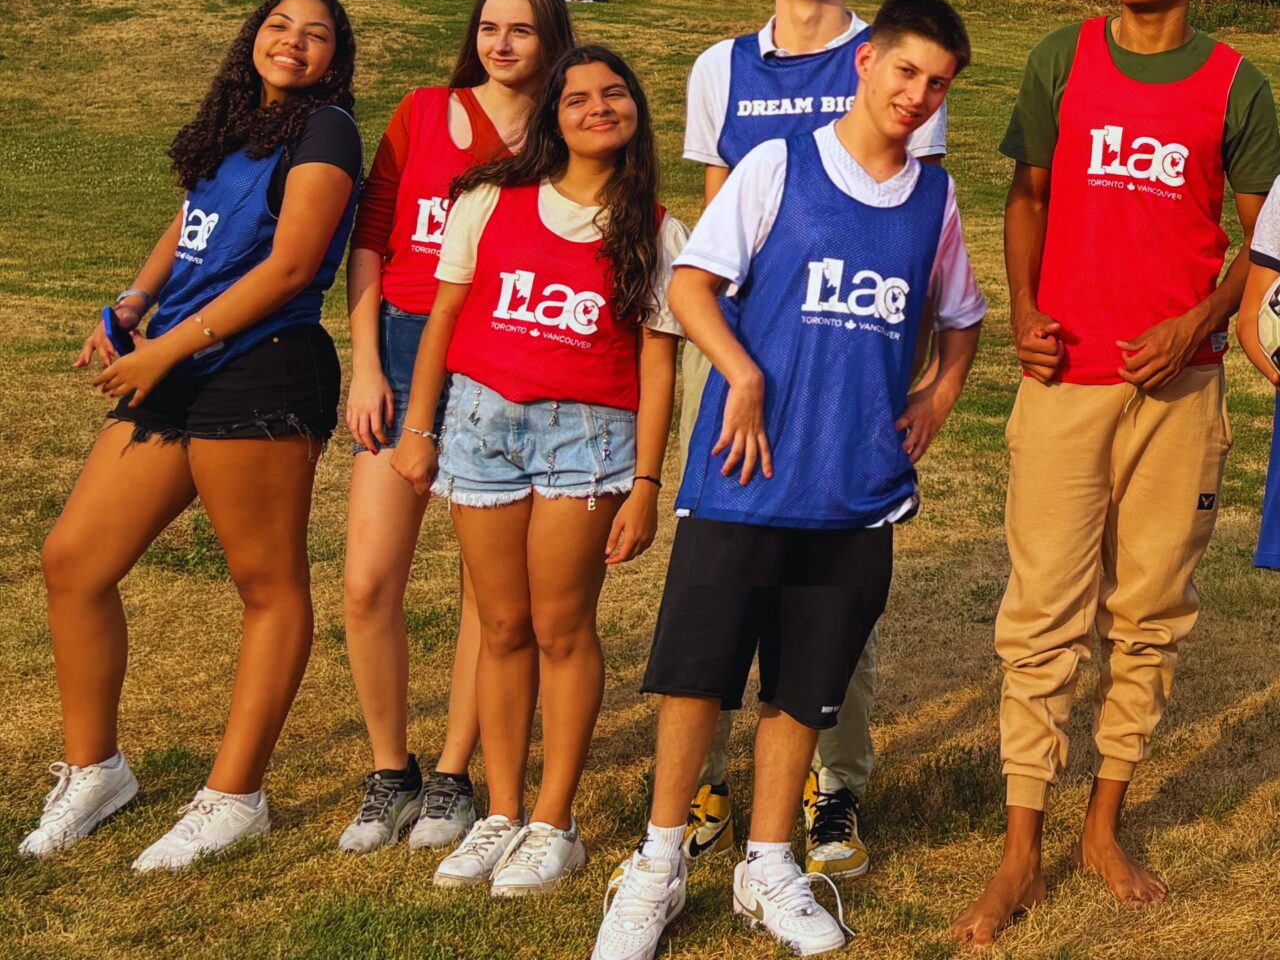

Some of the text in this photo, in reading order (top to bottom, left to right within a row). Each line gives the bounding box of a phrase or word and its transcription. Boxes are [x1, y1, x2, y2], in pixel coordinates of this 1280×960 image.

[737, 97, 814, 116] DREAM
[1087, 178, 1182, 200] TORONTO VANCOUVER
[801, 315, 842, 328] TORONTO
[491, 321, 592, 349] TORONTO VANCOUVER
